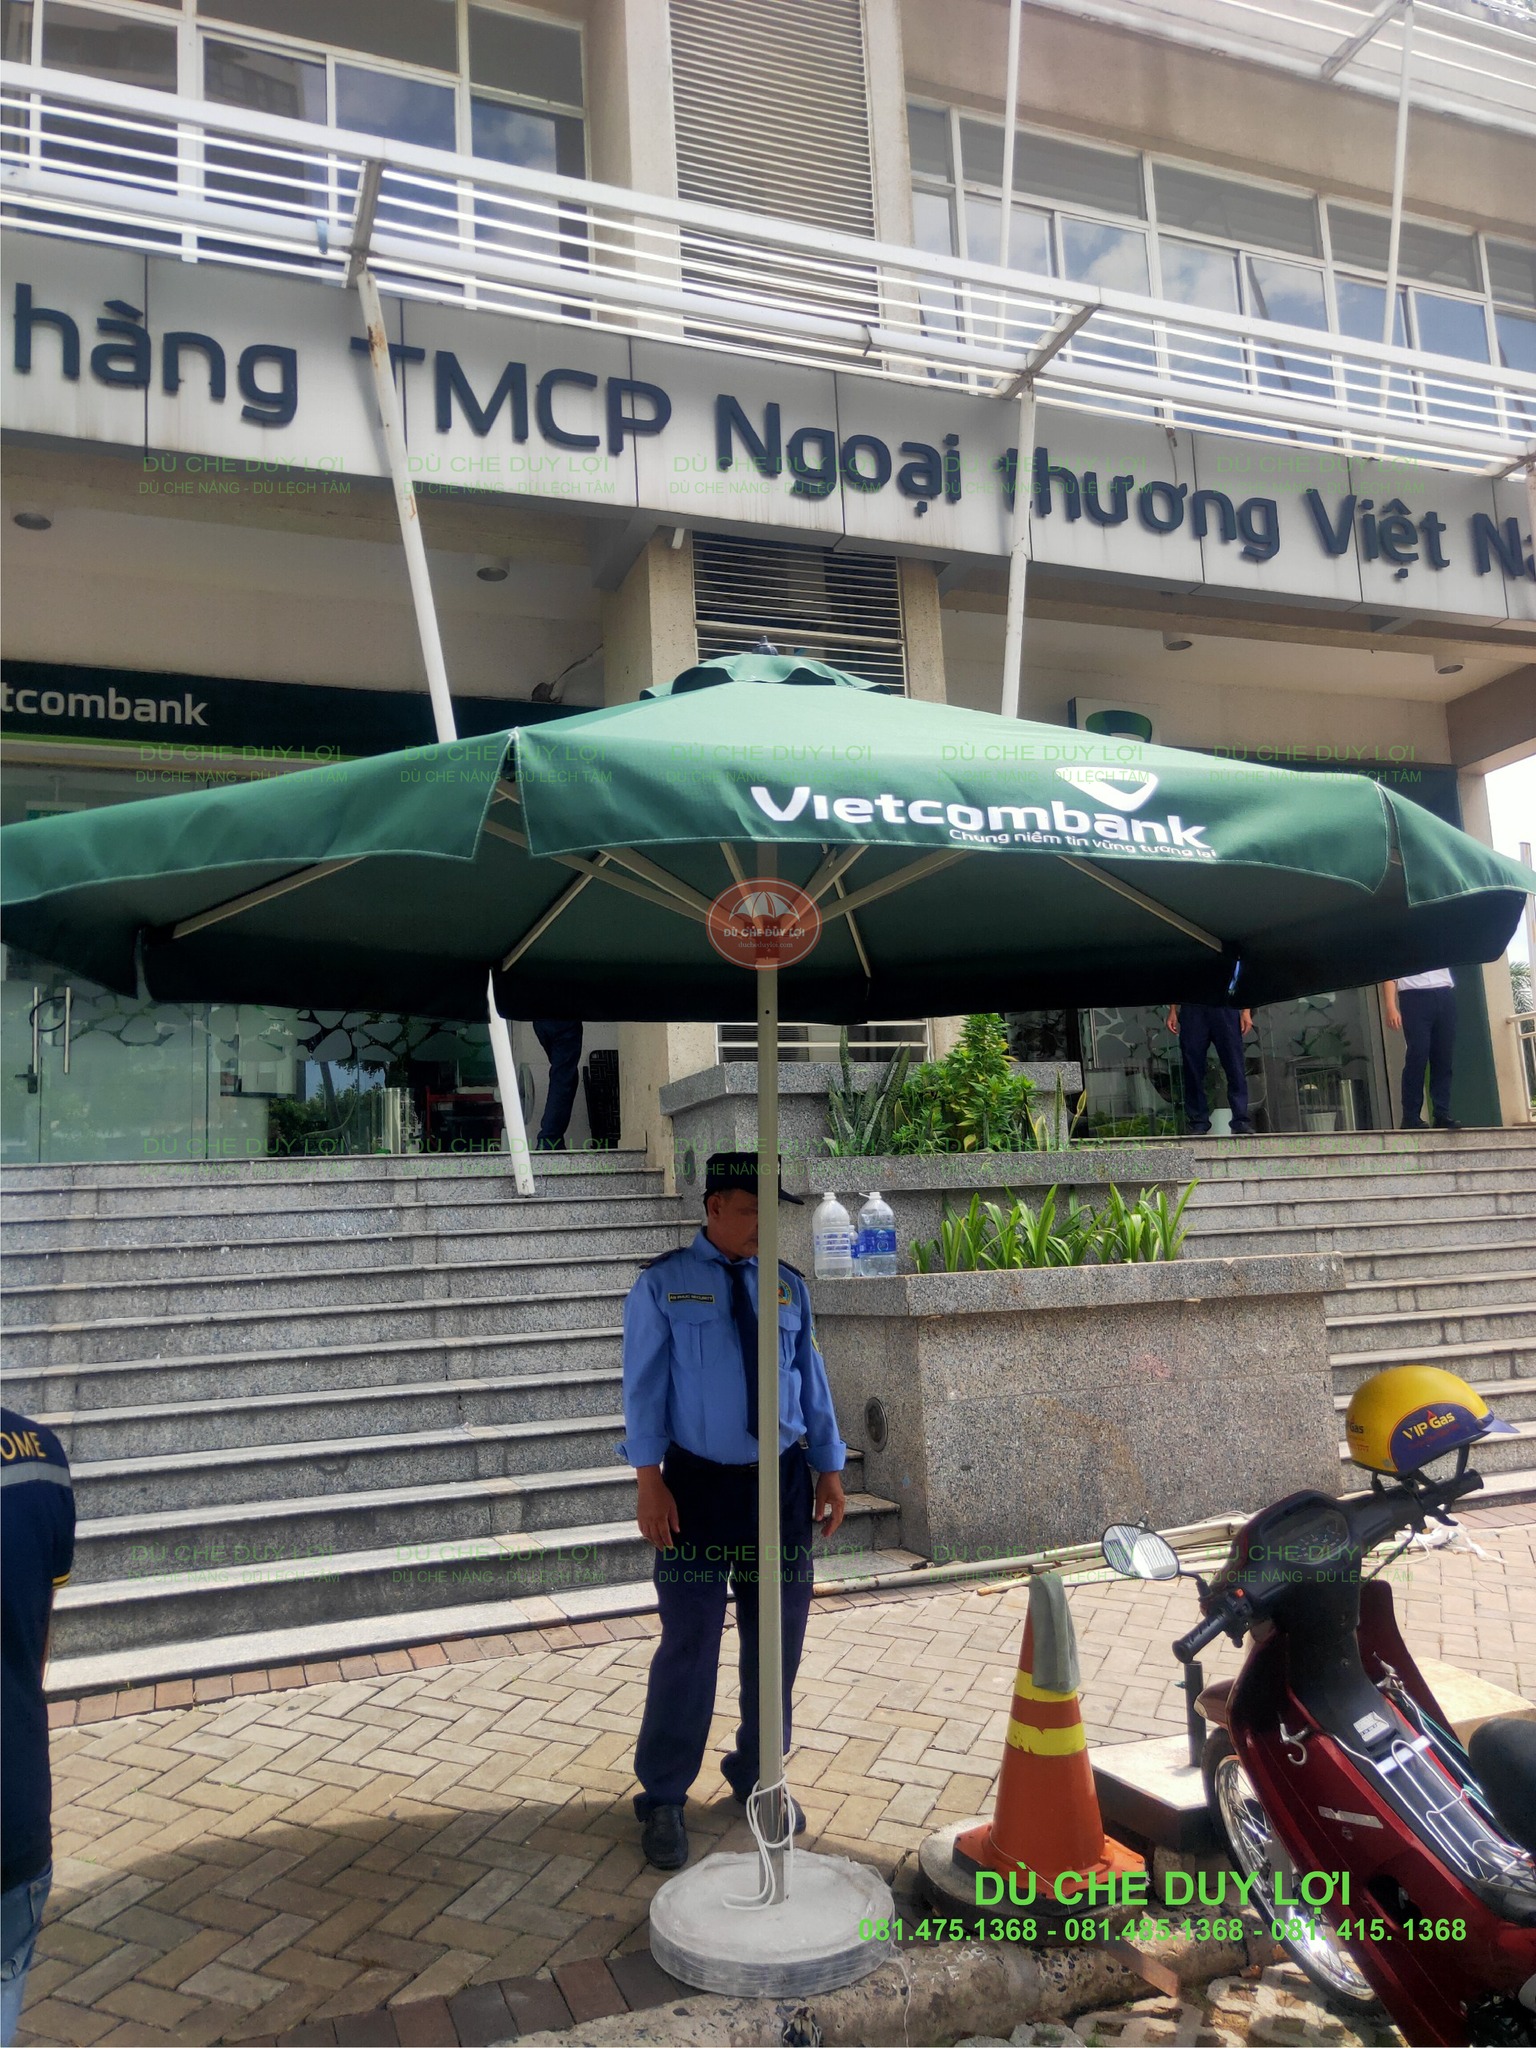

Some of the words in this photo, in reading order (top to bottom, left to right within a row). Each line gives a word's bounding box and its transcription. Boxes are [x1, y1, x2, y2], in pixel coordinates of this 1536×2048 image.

[13, 282, 298, 425] hàng
[716, 394, 962, 516] Ngoại
[1304, 488, 1450, 579] Việt
[1471, 512, 1536, 581] N
[1, 681, 209, 727] tcombank
[750, 786, 1213, 851] Vietcombank
[949, 829, 1009, 844] Chung
[1065, 834, 1088, 847] tin
[0, 1430, 47, 1460] OME
[1402, 1421, 1428, 1440] VIP
[1429, 1412, 1456, 1429] Gas
